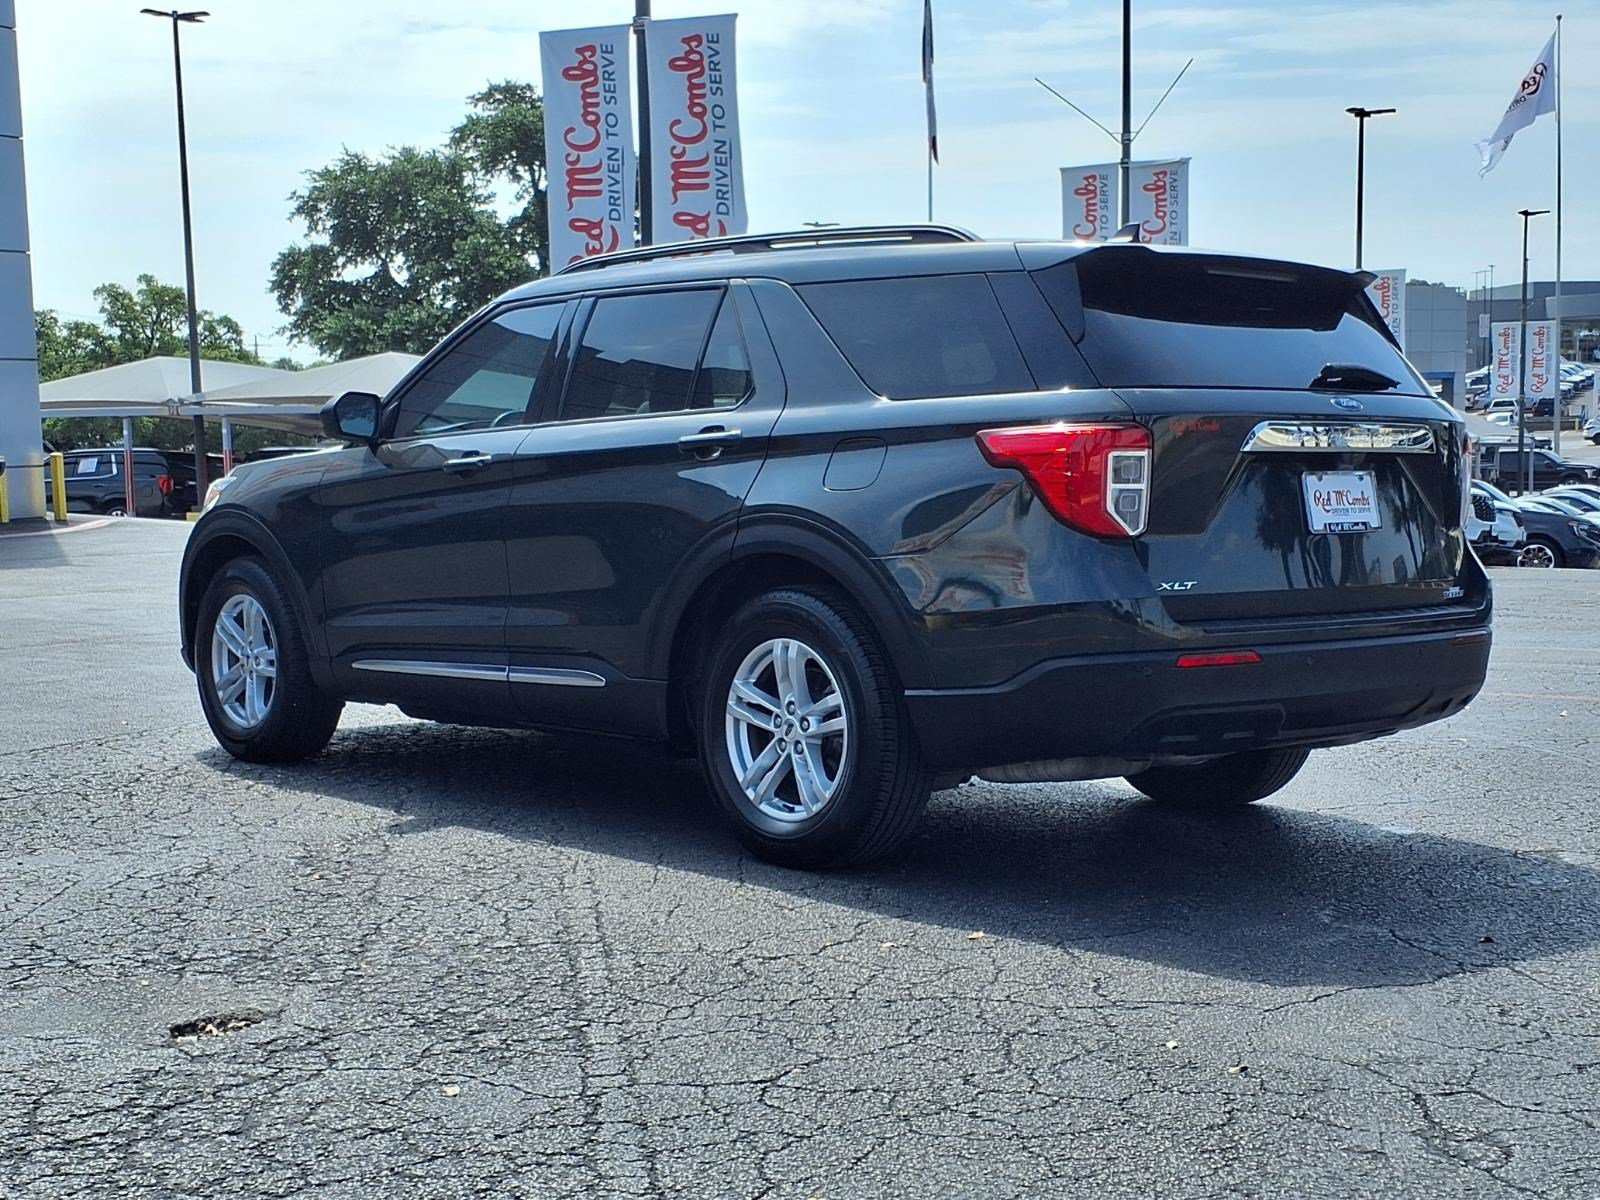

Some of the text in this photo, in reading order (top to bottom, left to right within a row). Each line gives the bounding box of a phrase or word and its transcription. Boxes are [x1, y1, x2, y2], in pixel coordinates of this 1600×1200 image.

[562, 44, 603, 211] McCombs
[600, 43, 622, 222] DRIVEN TO SERVE
[668, 33, 710, 205] McCombs
[706, 33, 730, 216] DRIVEN TO SERVE
[1099, 173, 1109, 211] SERVE
[1169, 169, 1179, 206] SERVE
[1073, 174, 1097, 241] Combs
[1100, 214, 1109, 232] TO
[1169, 209, 1179, 229] TO
[1374, 276, 1390, 319] Combs
[1391, 275, 1399, 302] SERVE
[1391, 303, 1399, 316] TO
[1496, 374, 1515, 393] Red
[1531, 373, 1549, 393] Red
[1313, 489, 1371, 513] Red McCombs
[1155, 581, 1198, 591] XLT
